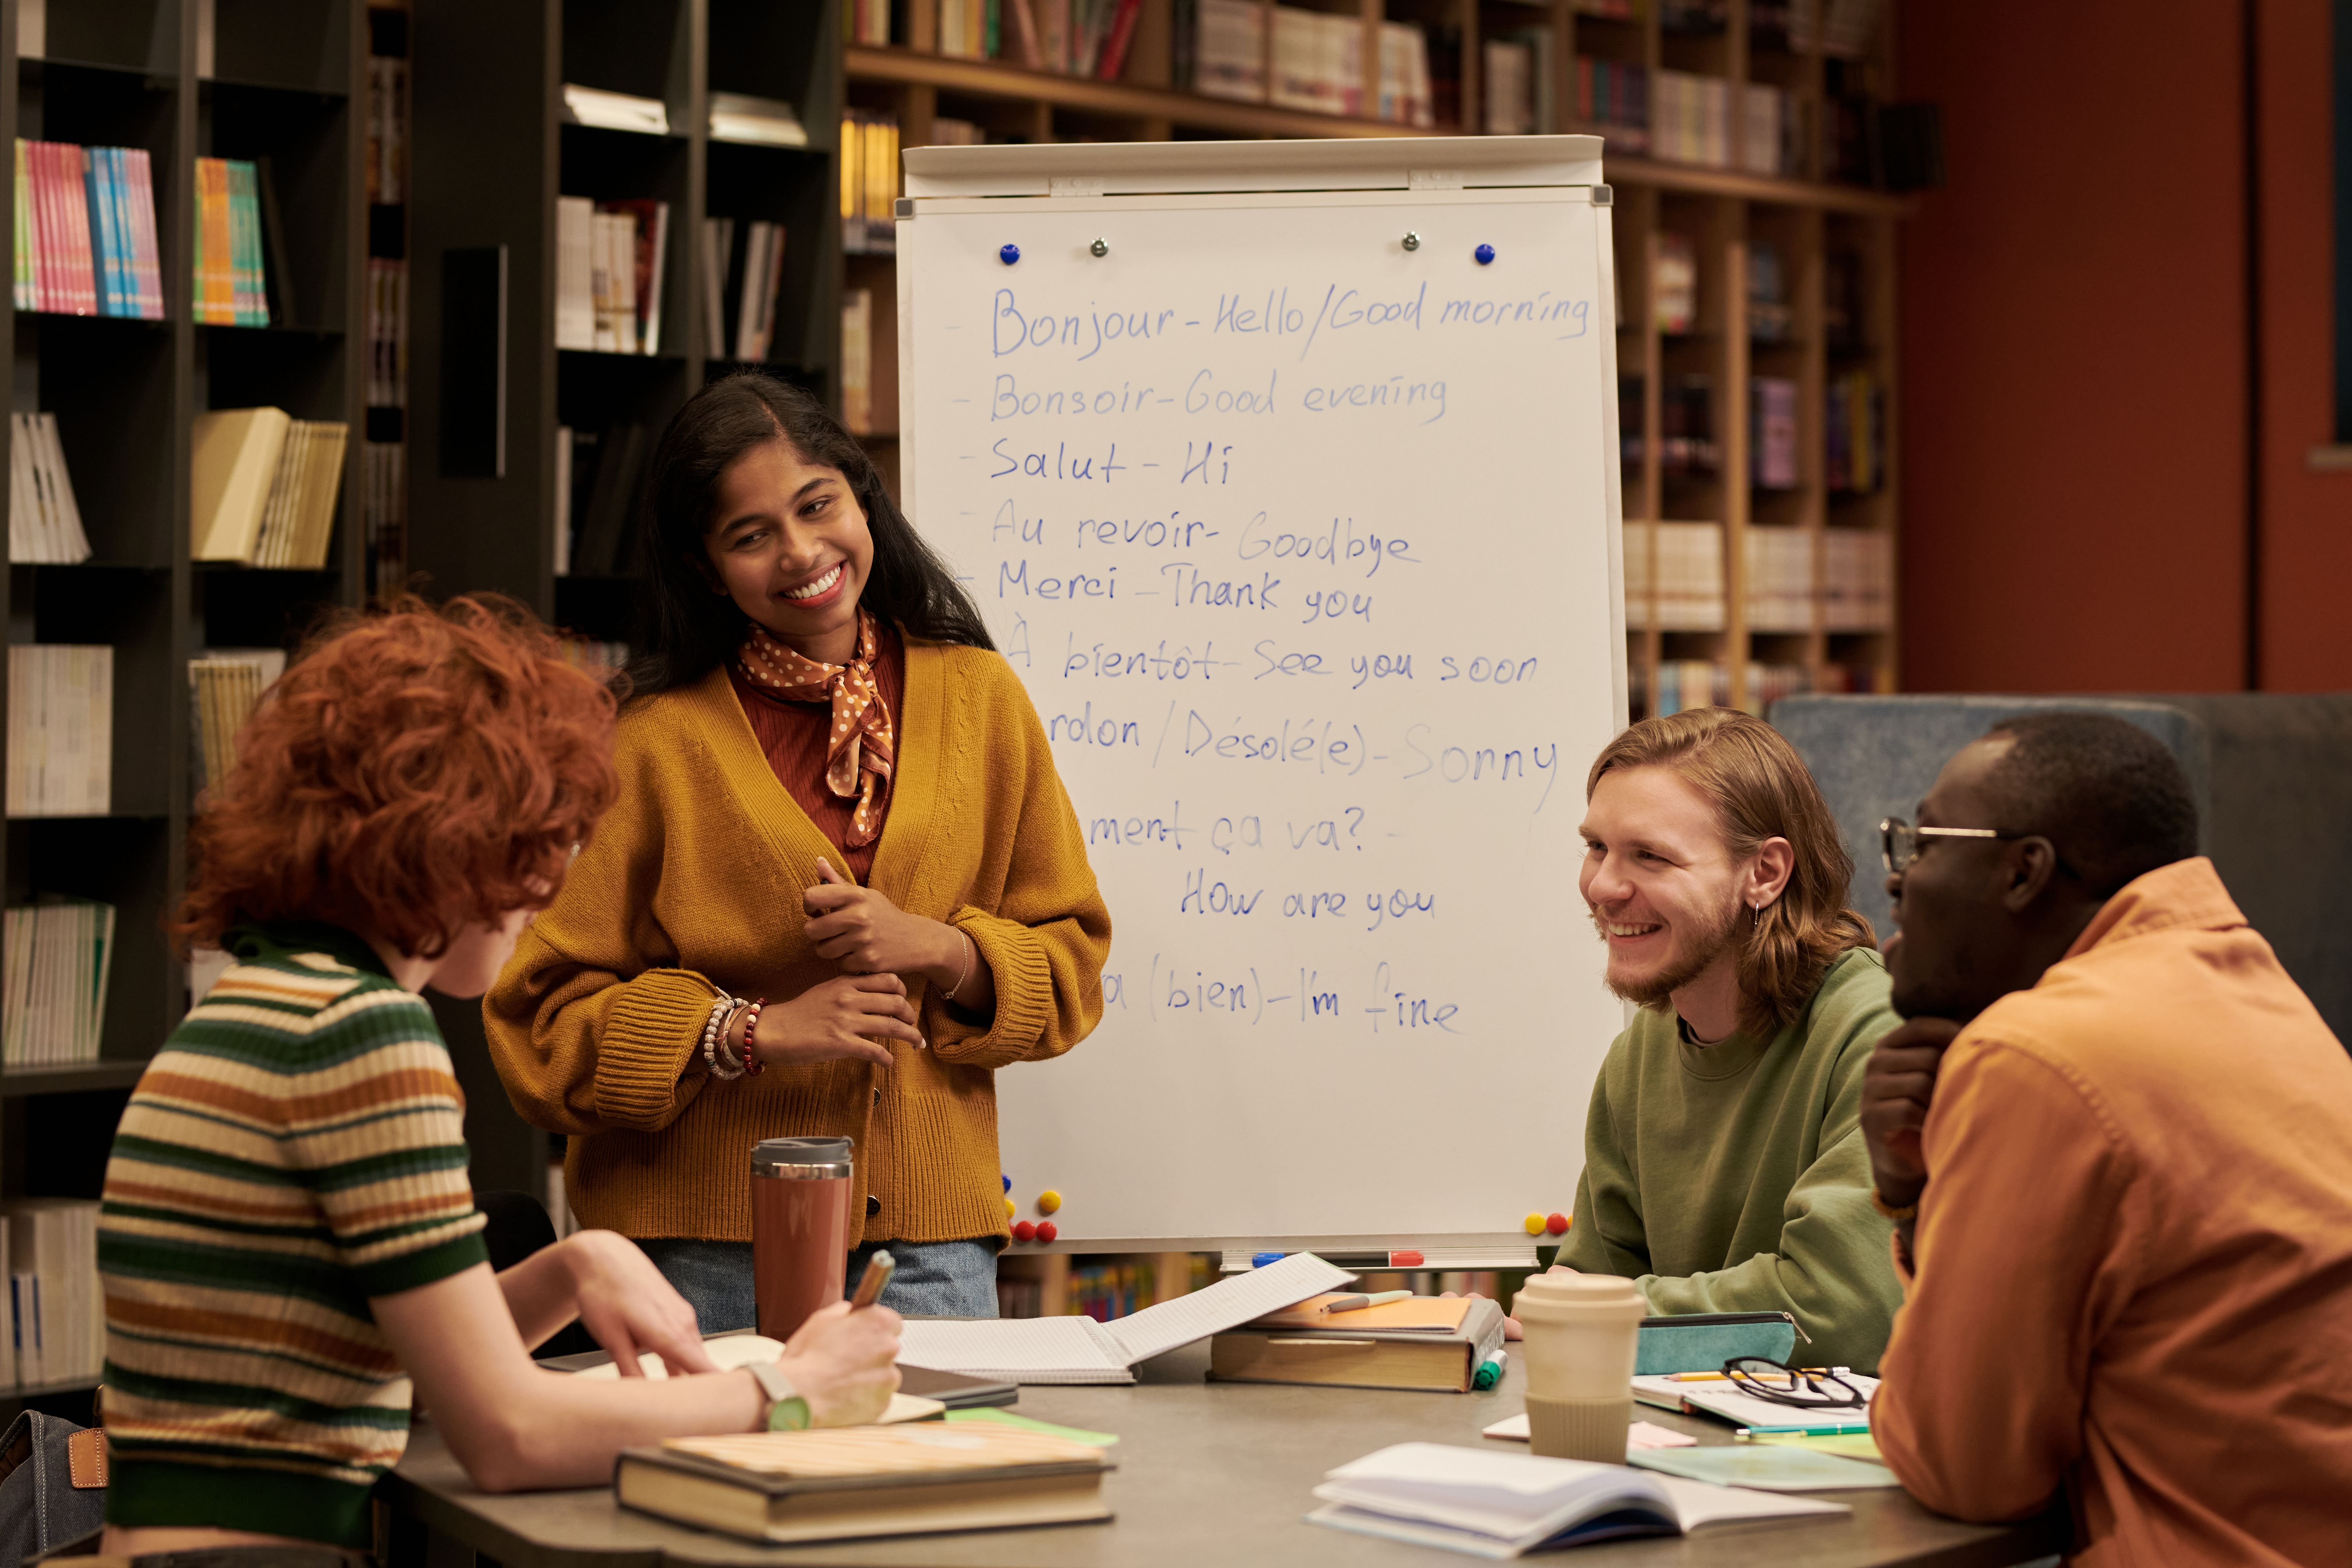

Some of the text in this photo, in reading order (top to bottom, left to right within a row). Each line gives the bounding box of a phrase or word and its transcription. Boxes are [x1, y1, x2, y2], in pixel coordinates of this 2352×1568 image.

[993, 287, 1175, 362] Bonjour
[1440, 291, 1589, 340] morning
[991, 373, 1154, 422] Bonsoir
[1185, 368, 1277, 415] Good
[1302, 375, 1447, 425] evening
[991, 437, 1127, 484] Salut
[1180, 440, 1233, 485] Hi
[993, 498, 1044, 546] Au
[1238, 511, 1421, 579] Goodbye
[999, 559, 1118, 600] Merci
[1160, 562, 1281, 611] Thank
[1302, 590, 1373, 625] you
[1063, 631, 1220, 681] bientôt
[1252, 640, 1333, 681] See
[1351, 654, 1414, 691] you
[1440, 656, 1538, 685] soon
[1050, 700, 1140, 748] rdon
[1089, 799, 1197, 851] ment
[1211, 815, 1263, 856] ça
[1286, 806, 1365, 852] va?
[1283, 891, 1347, 919] are
[1366, 888, 1435, 932] you
[1101, 973, 1127, 1009] a
[1148, 952, 1262, 1027] (bien)
[1300, 967, 1340, 1023] I'm
[1364, 960, 1463, 1034] fine
